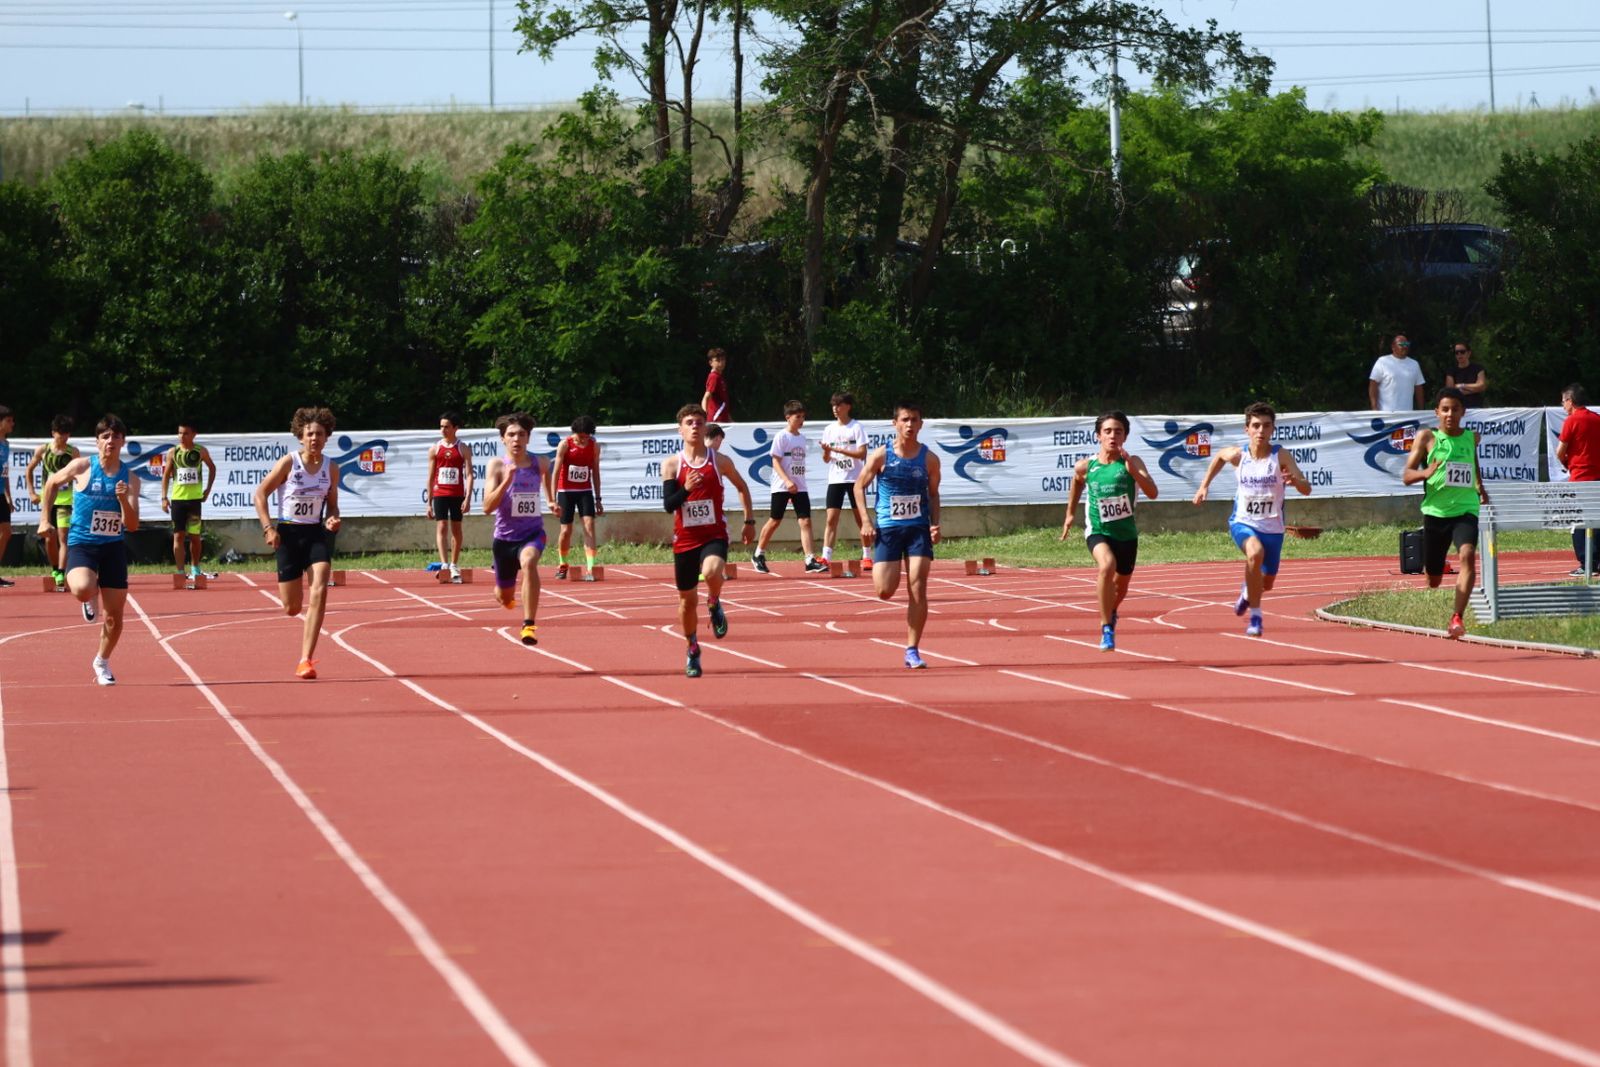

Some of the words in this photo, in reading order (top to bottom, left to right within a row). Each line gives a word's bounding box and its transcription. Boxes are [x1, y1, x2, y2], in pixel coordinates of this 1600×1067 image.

[1054, 430, 1099, 446] FEDERAC
[1271, 421, 1321, 440] DERACIÓN
[642, 439, 684, 454] FEDERA
[1479, 444, 1521, 459] LETISMO
[178, 472, 196, 482] 2494
[1447, 469, 1471, 484] 1210
[1510, 464, 1535, 481] LEÓN
[1042, 476, 1072, 491] CASTI
[212, 492, 255, 507] CASTILL
[518, 501, 535, 513] 693
[294, 502, 314, 515] 201
[687, 505, 710, 518] 1653
[892, 501, 918, 515] 2316
[1101, 502, 1129, 518] 3064
[1246, 501, 1273, 514] 4277
[93, 518, 120, 532] 3315
